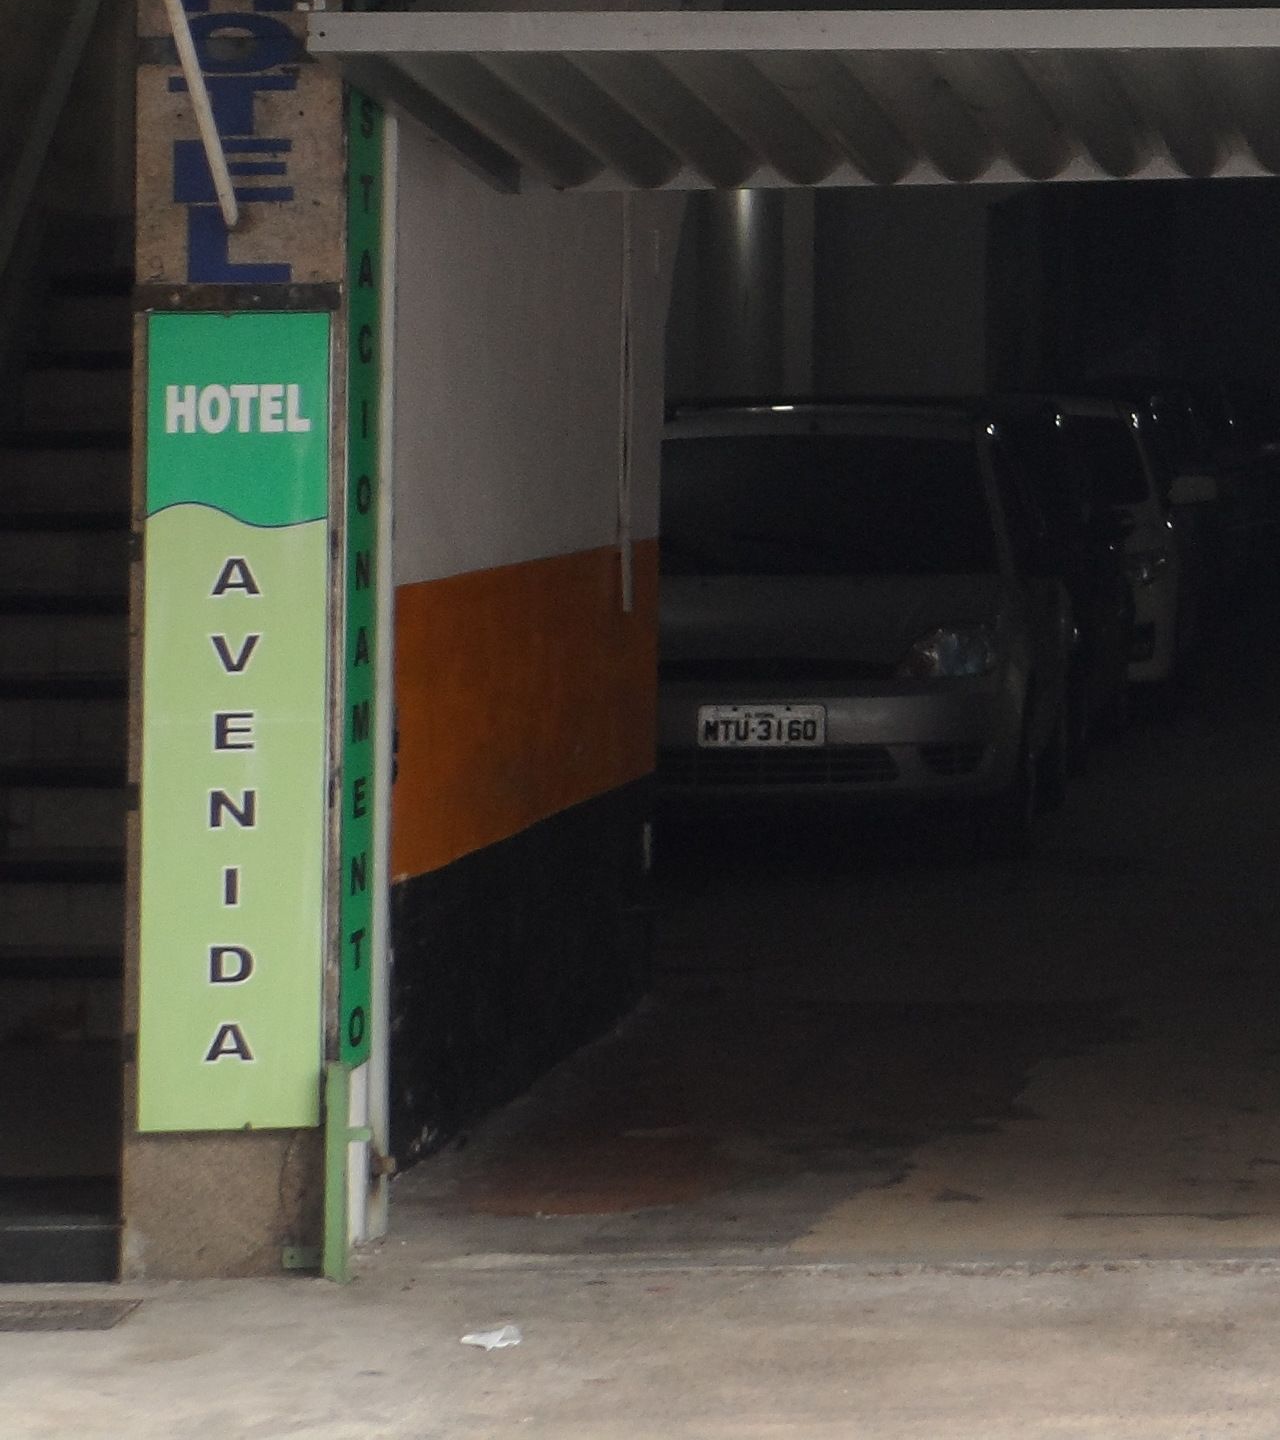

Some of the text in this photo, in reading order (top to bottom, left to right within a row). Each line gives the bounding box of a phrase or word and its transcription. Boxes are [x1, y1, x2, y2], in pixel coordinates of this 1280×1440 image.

[164, 383, 312, 434] HOTEL
[347, 96, 376, 1048] STACIONAMENTO
[204, 556, 262, 1062] AVENIDA
